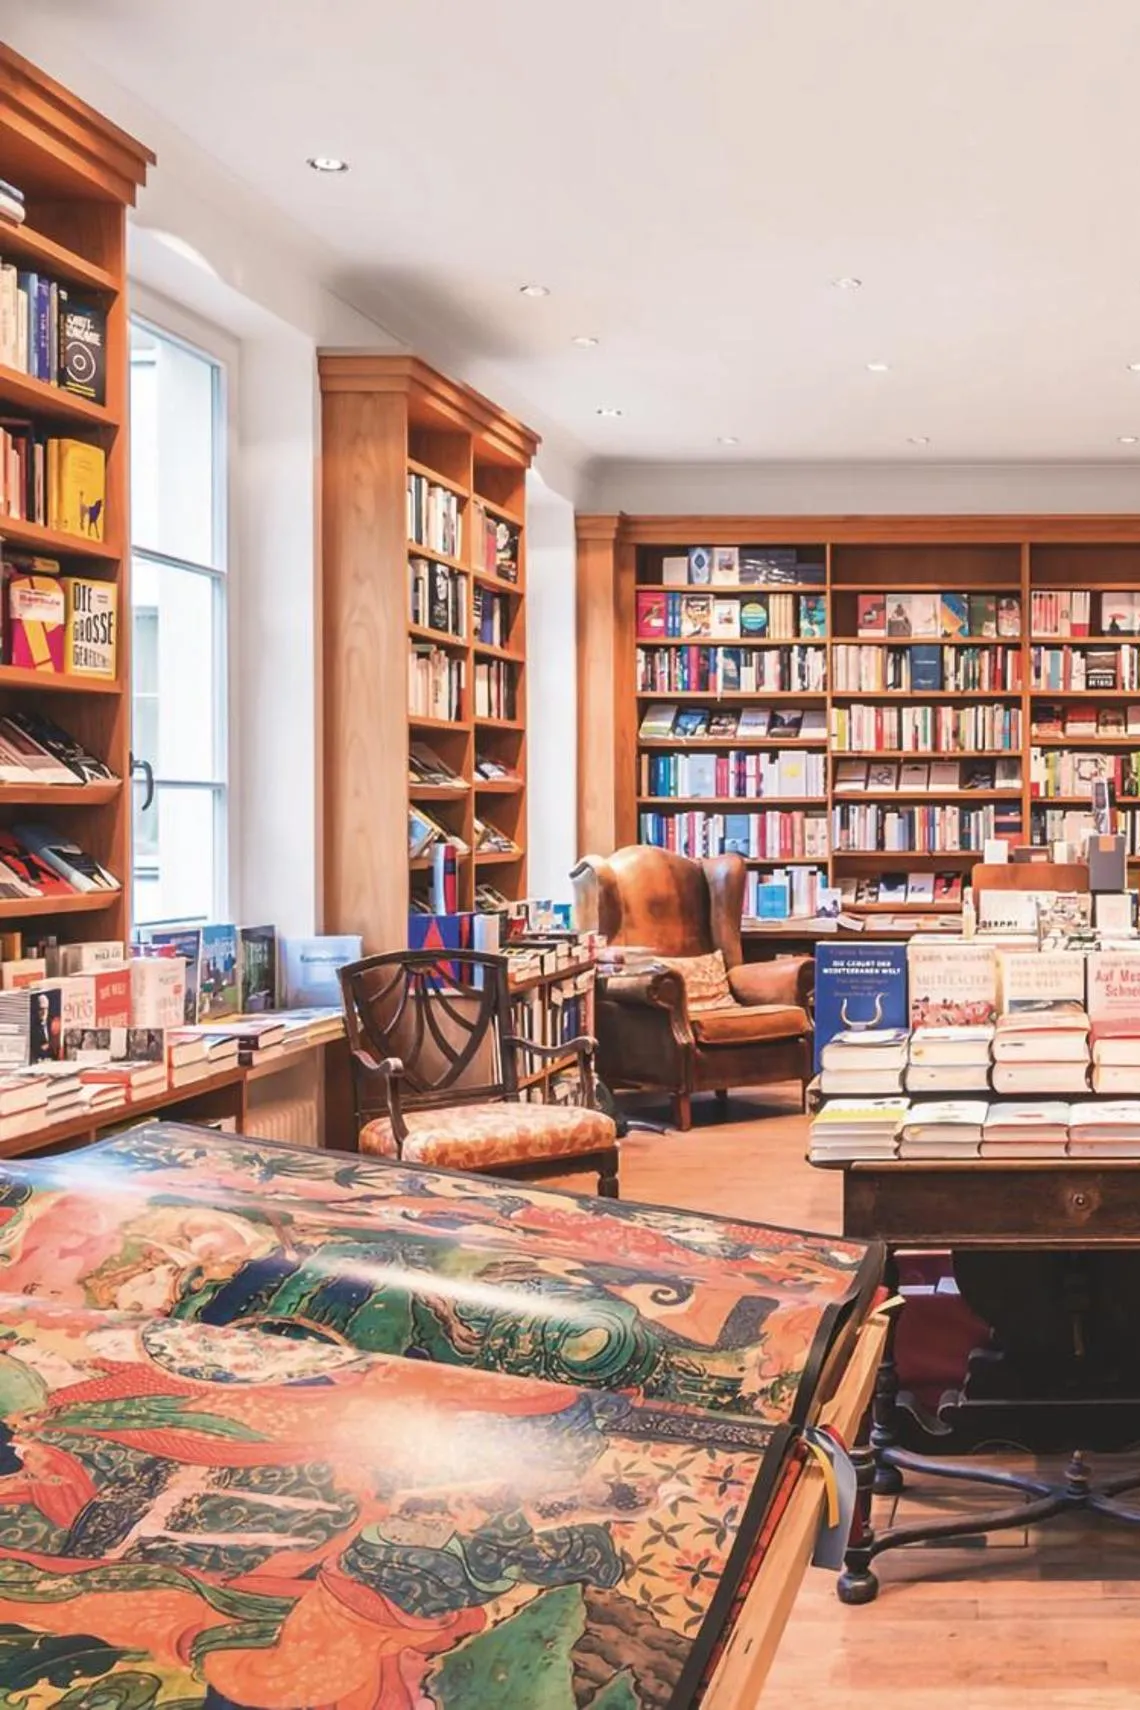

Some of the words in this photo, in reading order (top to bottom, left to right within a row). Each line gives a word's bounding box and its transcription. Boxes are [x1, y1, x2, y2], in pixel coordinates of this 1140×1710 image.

[73, 582, 92, 613] DIE
[73, 611, 114, 645] GROSSE
[1095, 970, 1114, 982] Auf
